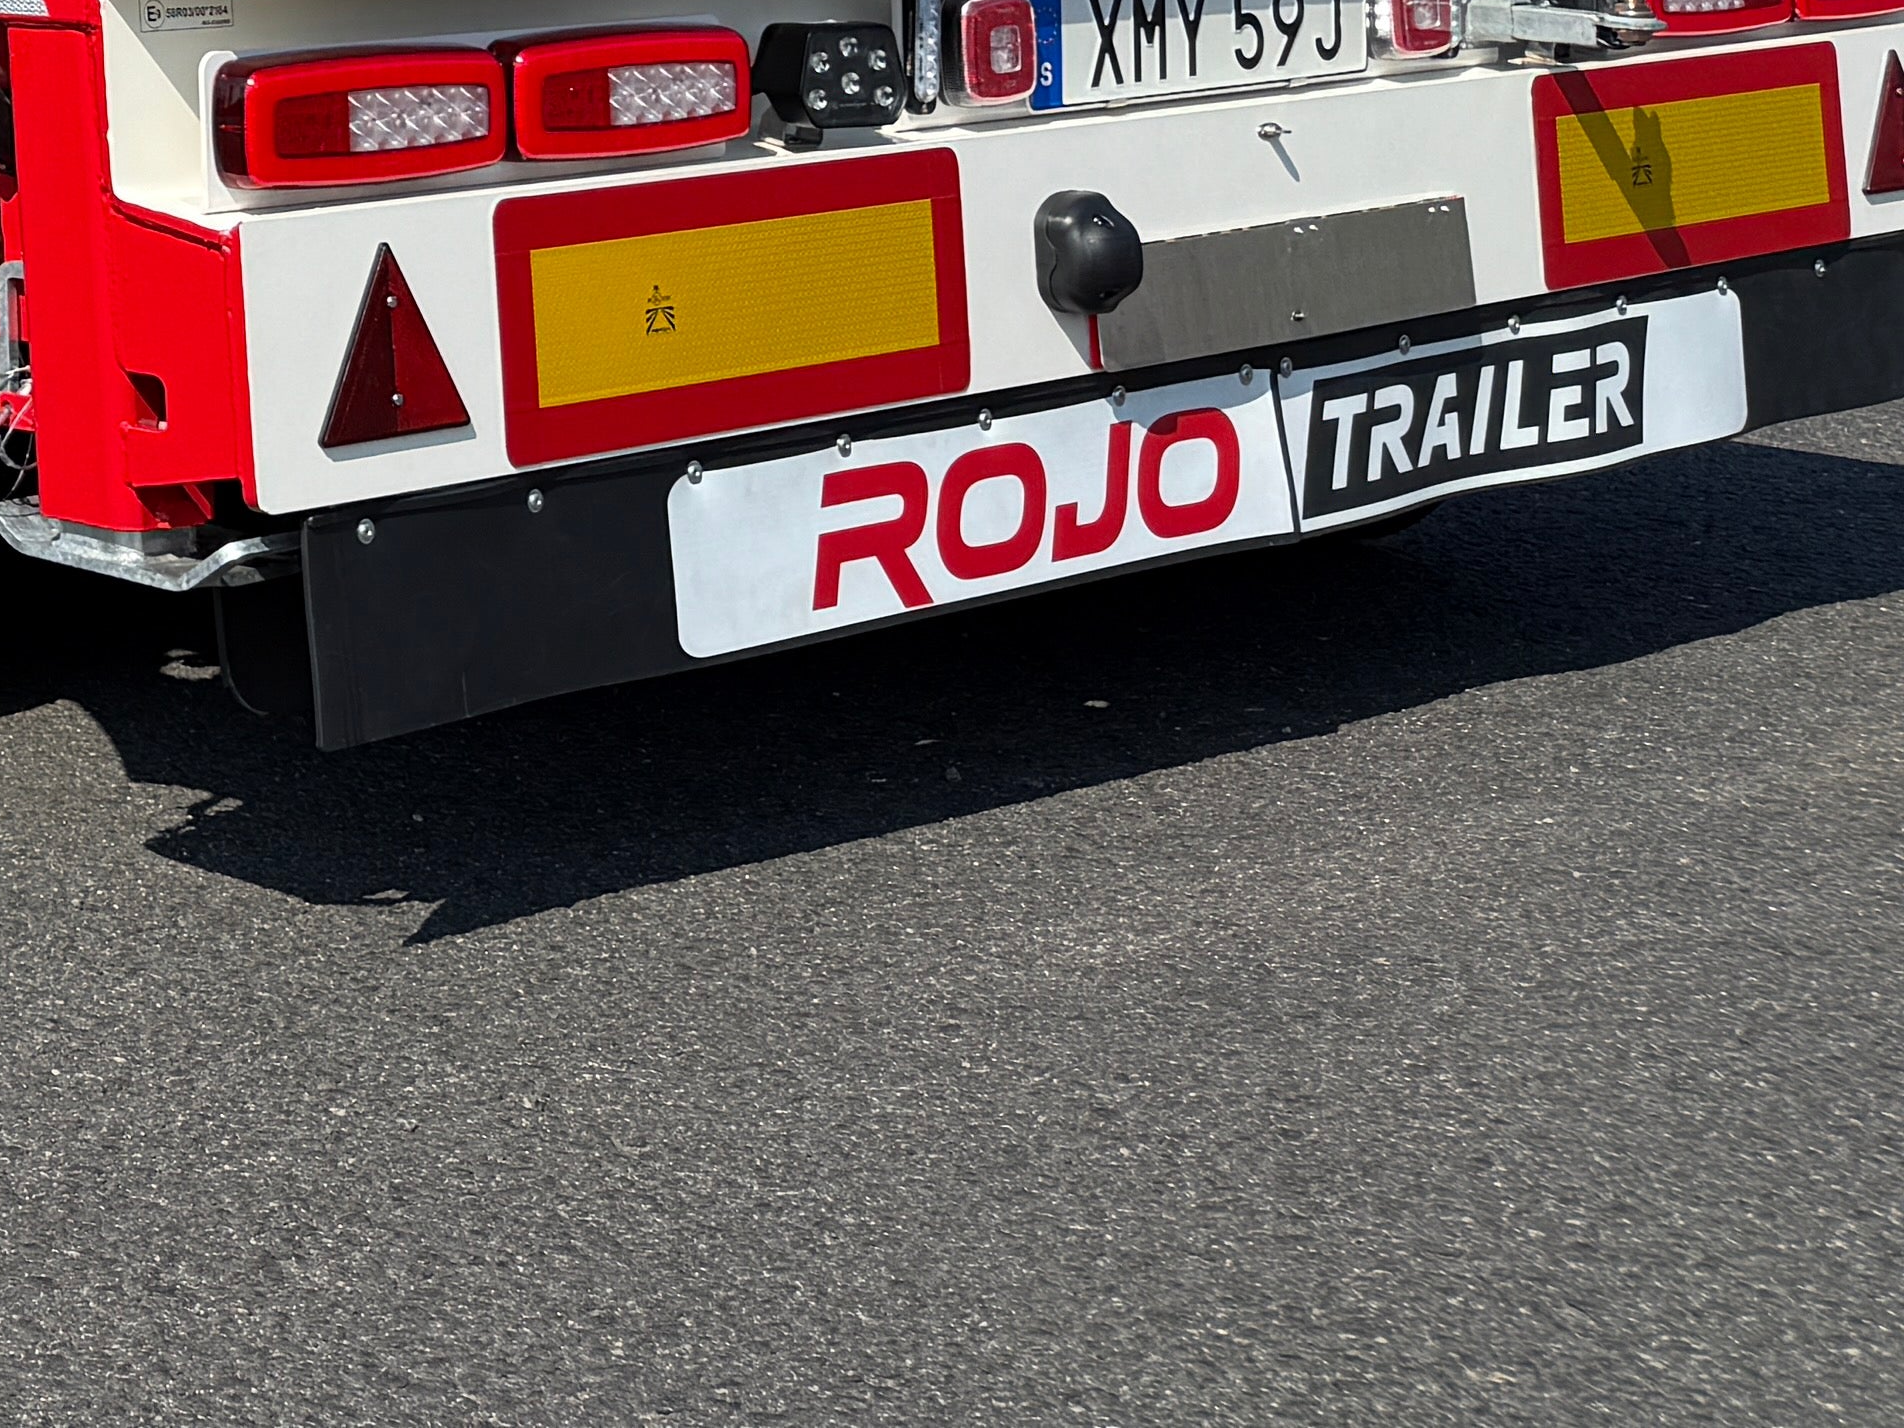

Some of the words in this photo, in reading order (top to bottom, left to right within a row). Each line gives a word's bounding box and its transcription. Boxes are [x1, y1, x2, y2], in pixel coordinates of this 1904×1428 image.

[1040, 62, 1053, 87] S
[811, 406, 1240, 611] ROJO
[1320, 340, 1635, 491] TRAILER
